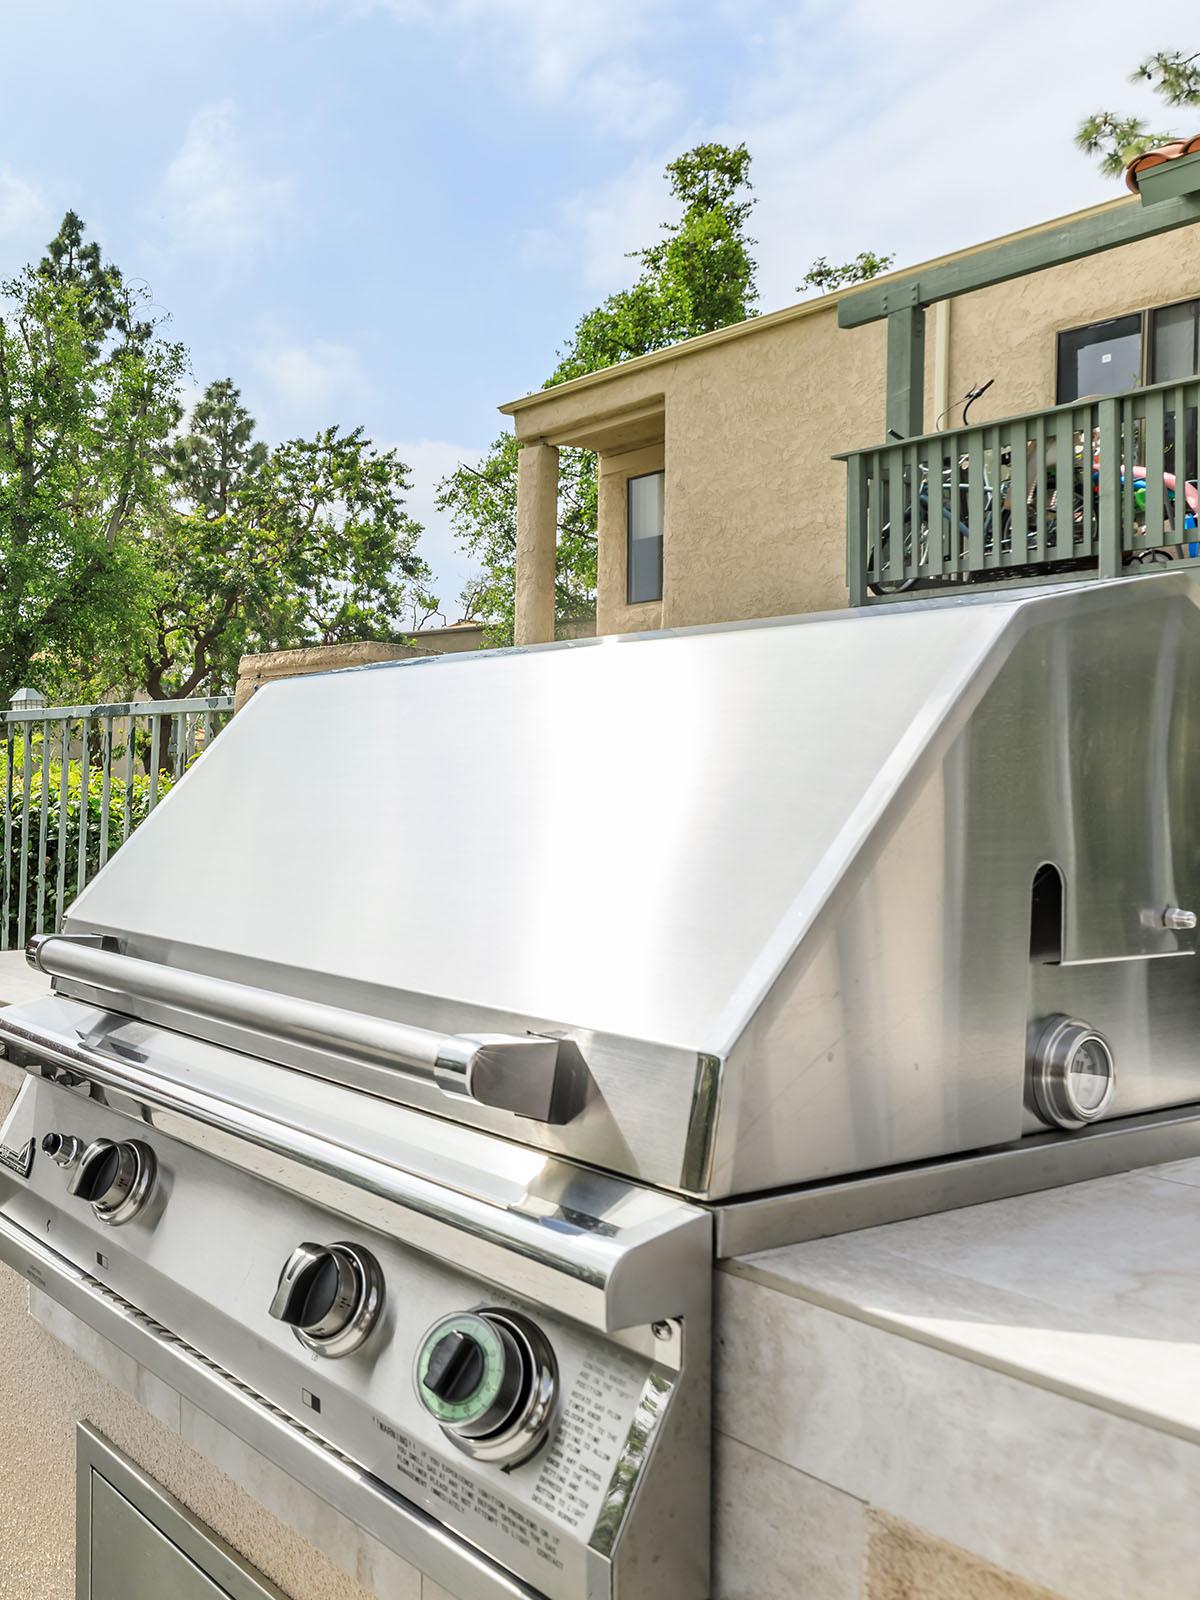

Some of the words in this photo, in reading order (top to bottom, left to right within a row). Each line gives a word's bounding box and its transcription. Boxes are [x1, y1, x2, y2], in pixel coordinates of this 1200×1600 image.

[602, 1381, 613, 1392] THE
[568, 1399, 585, 1413] TIMER
[587, 1410, 601, 1422] KNOB
[593, 1402, 605, 1413] GAS
[563, 1409, 594, 1430] CLOCKWISE
[597, 1425, 605, 1436] TO
[607, 1432, 618, 1443] THE
[583, 1441, 591, 1451] TO
[397, 1463, 427, 1488] MANAGEMENT
[546, 1456, 560, 1468] KNOB
[562, 1465, 570, 1475] TO
[573, 1471, 583, 1482] THE
[551, 1446, 564, 1459] TURN
[566, 1457, 576, 1465] ANY
[578, 1464, 602, 1482] CONTROL
[538, 1474, 563, 1494] DEPRESS
[542, 1465, 566, 1484] SETTING
[568, 1482, 579, 1491] AND
[397, 1444, 407, 1455] YOU
[409, 1452, 424, 1467] SMELL
[426, 1464, 437, 1475] GAS
[438, 1472, 446, 1481] AT
[448, 1478, 458, 1488] ANY
[461, 1486, 474, 1500] TIME
[477, 1497, 498, 1516] BEFORE
[501, 1513, 527, 1536] OPENING
[530, 1531, 541, 1545] THE
[544, 1542, 557, 1555] GAS
[441, 1463, 474, 1490] EXPERIENCE
[478, 1488, 505, 1510] IGNITION
[508, 1506, 537, 1531] PROBLEMS
[540, 1528, 549, 1538] OR
[535, 1484, 555, 1501] BUTTON
[558, 1497, 566, 1508] TO
[396, 1453, 409, 1467] FLOW
[412, 1463, 427, 1478] TIMER
[429, 1475, 448, 1493] PLEASE
[451, 1489, 459, 1500] DO
[474, 1505, 498, 1526] ATTEMPT
[501, 1523, 509, 1534] TO
[536, 1547, 564, 1570] CONTACT
